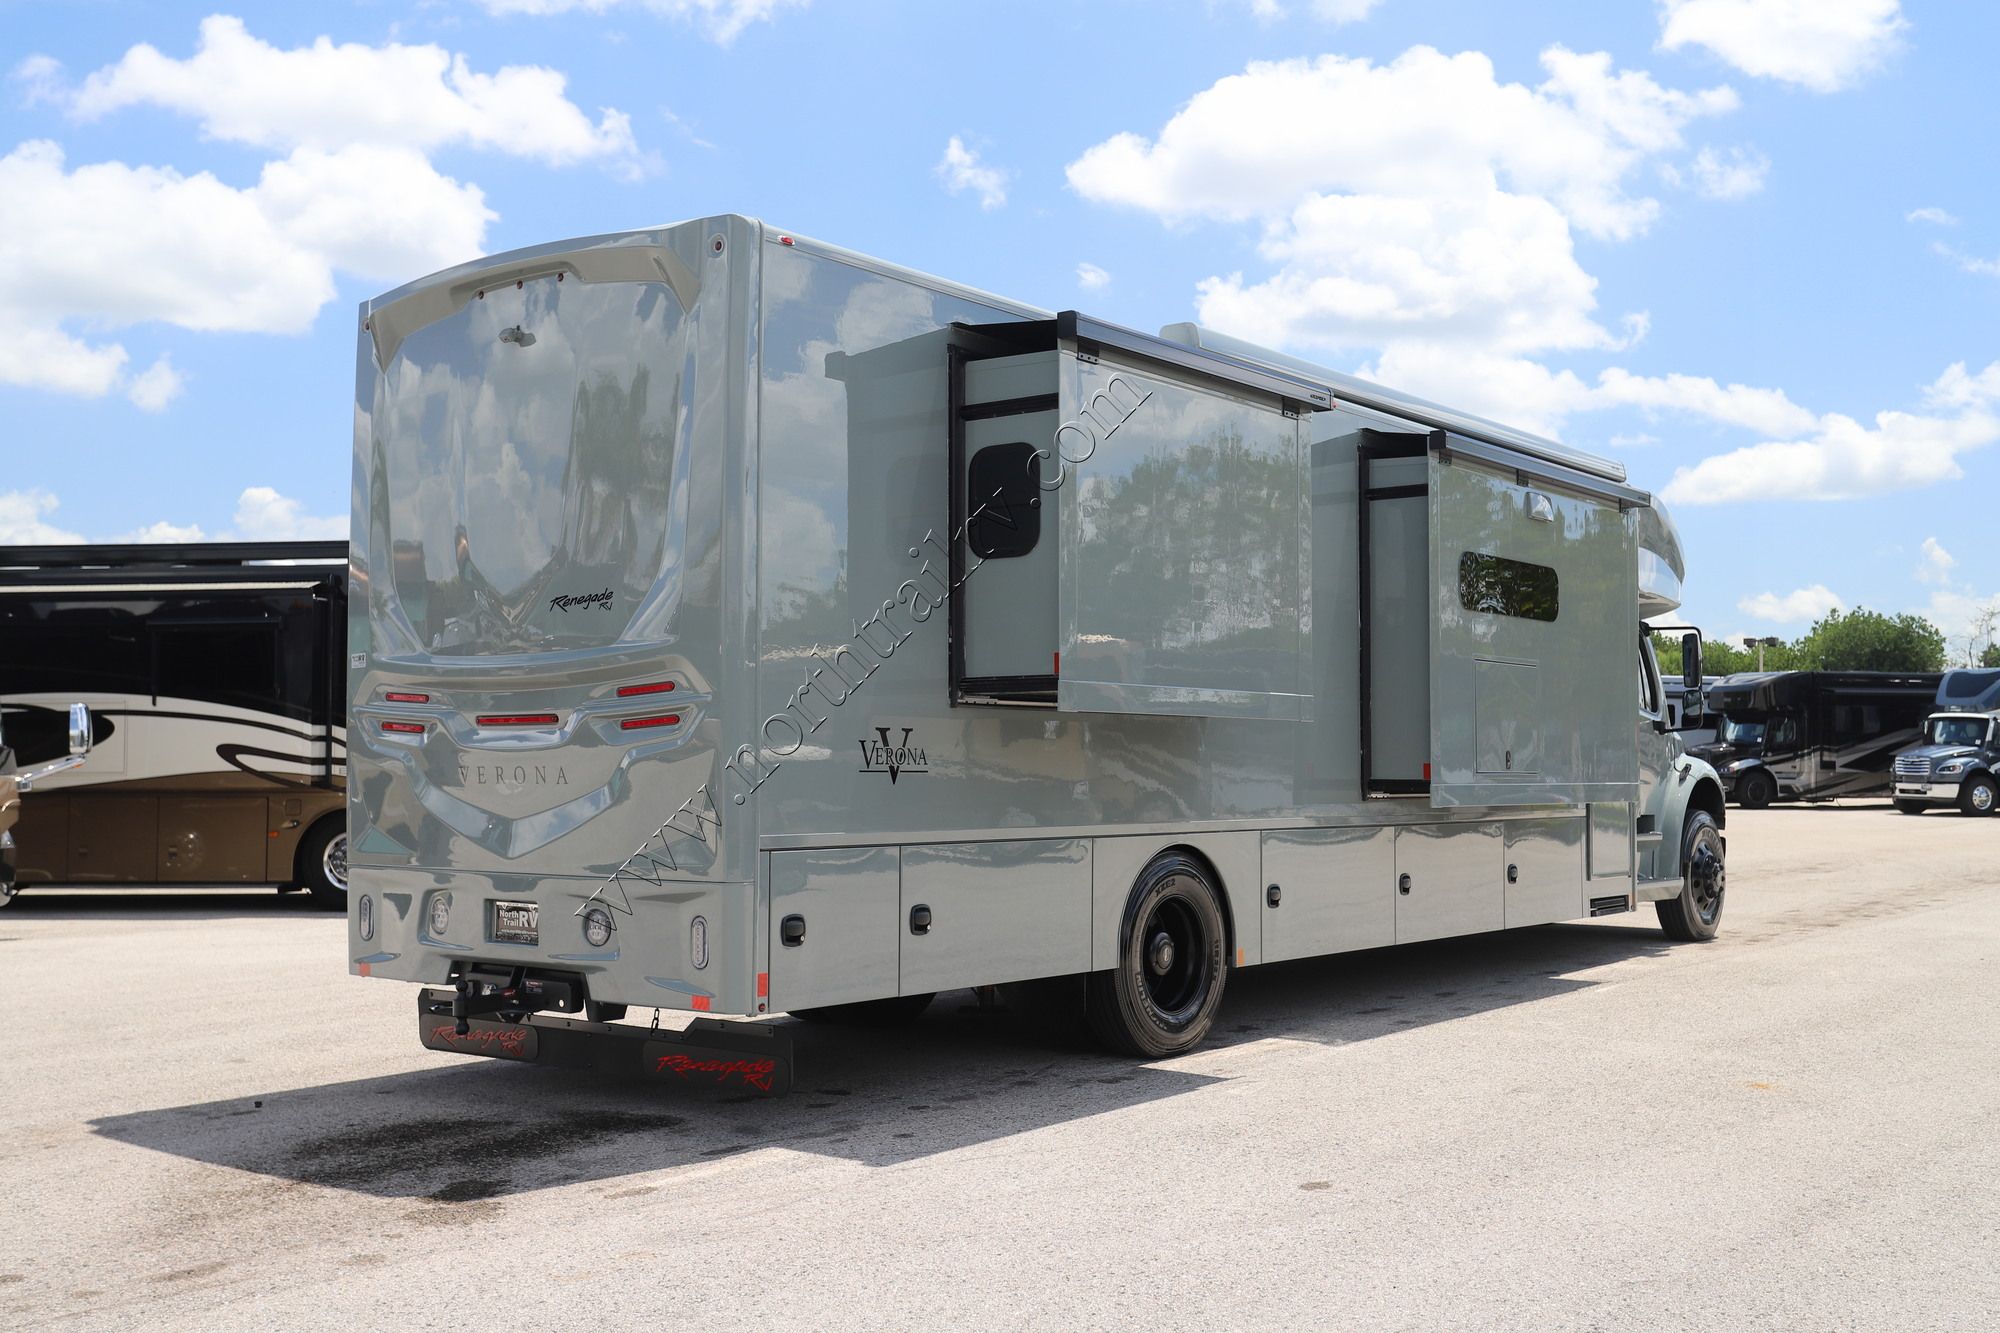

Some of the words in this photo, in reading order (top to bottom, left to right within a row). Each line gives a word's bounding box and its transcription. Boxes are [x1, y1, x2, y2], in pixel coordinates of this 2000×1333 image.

[549, 587, 614, 613] Renegade
[598, 601, 613, 611] RV
[459, 765, 569, 785] VERONA
[499, 909, 519, 919] North
[519, 910, 539, 929] RV
[503, 918, 519, 927] Trail
